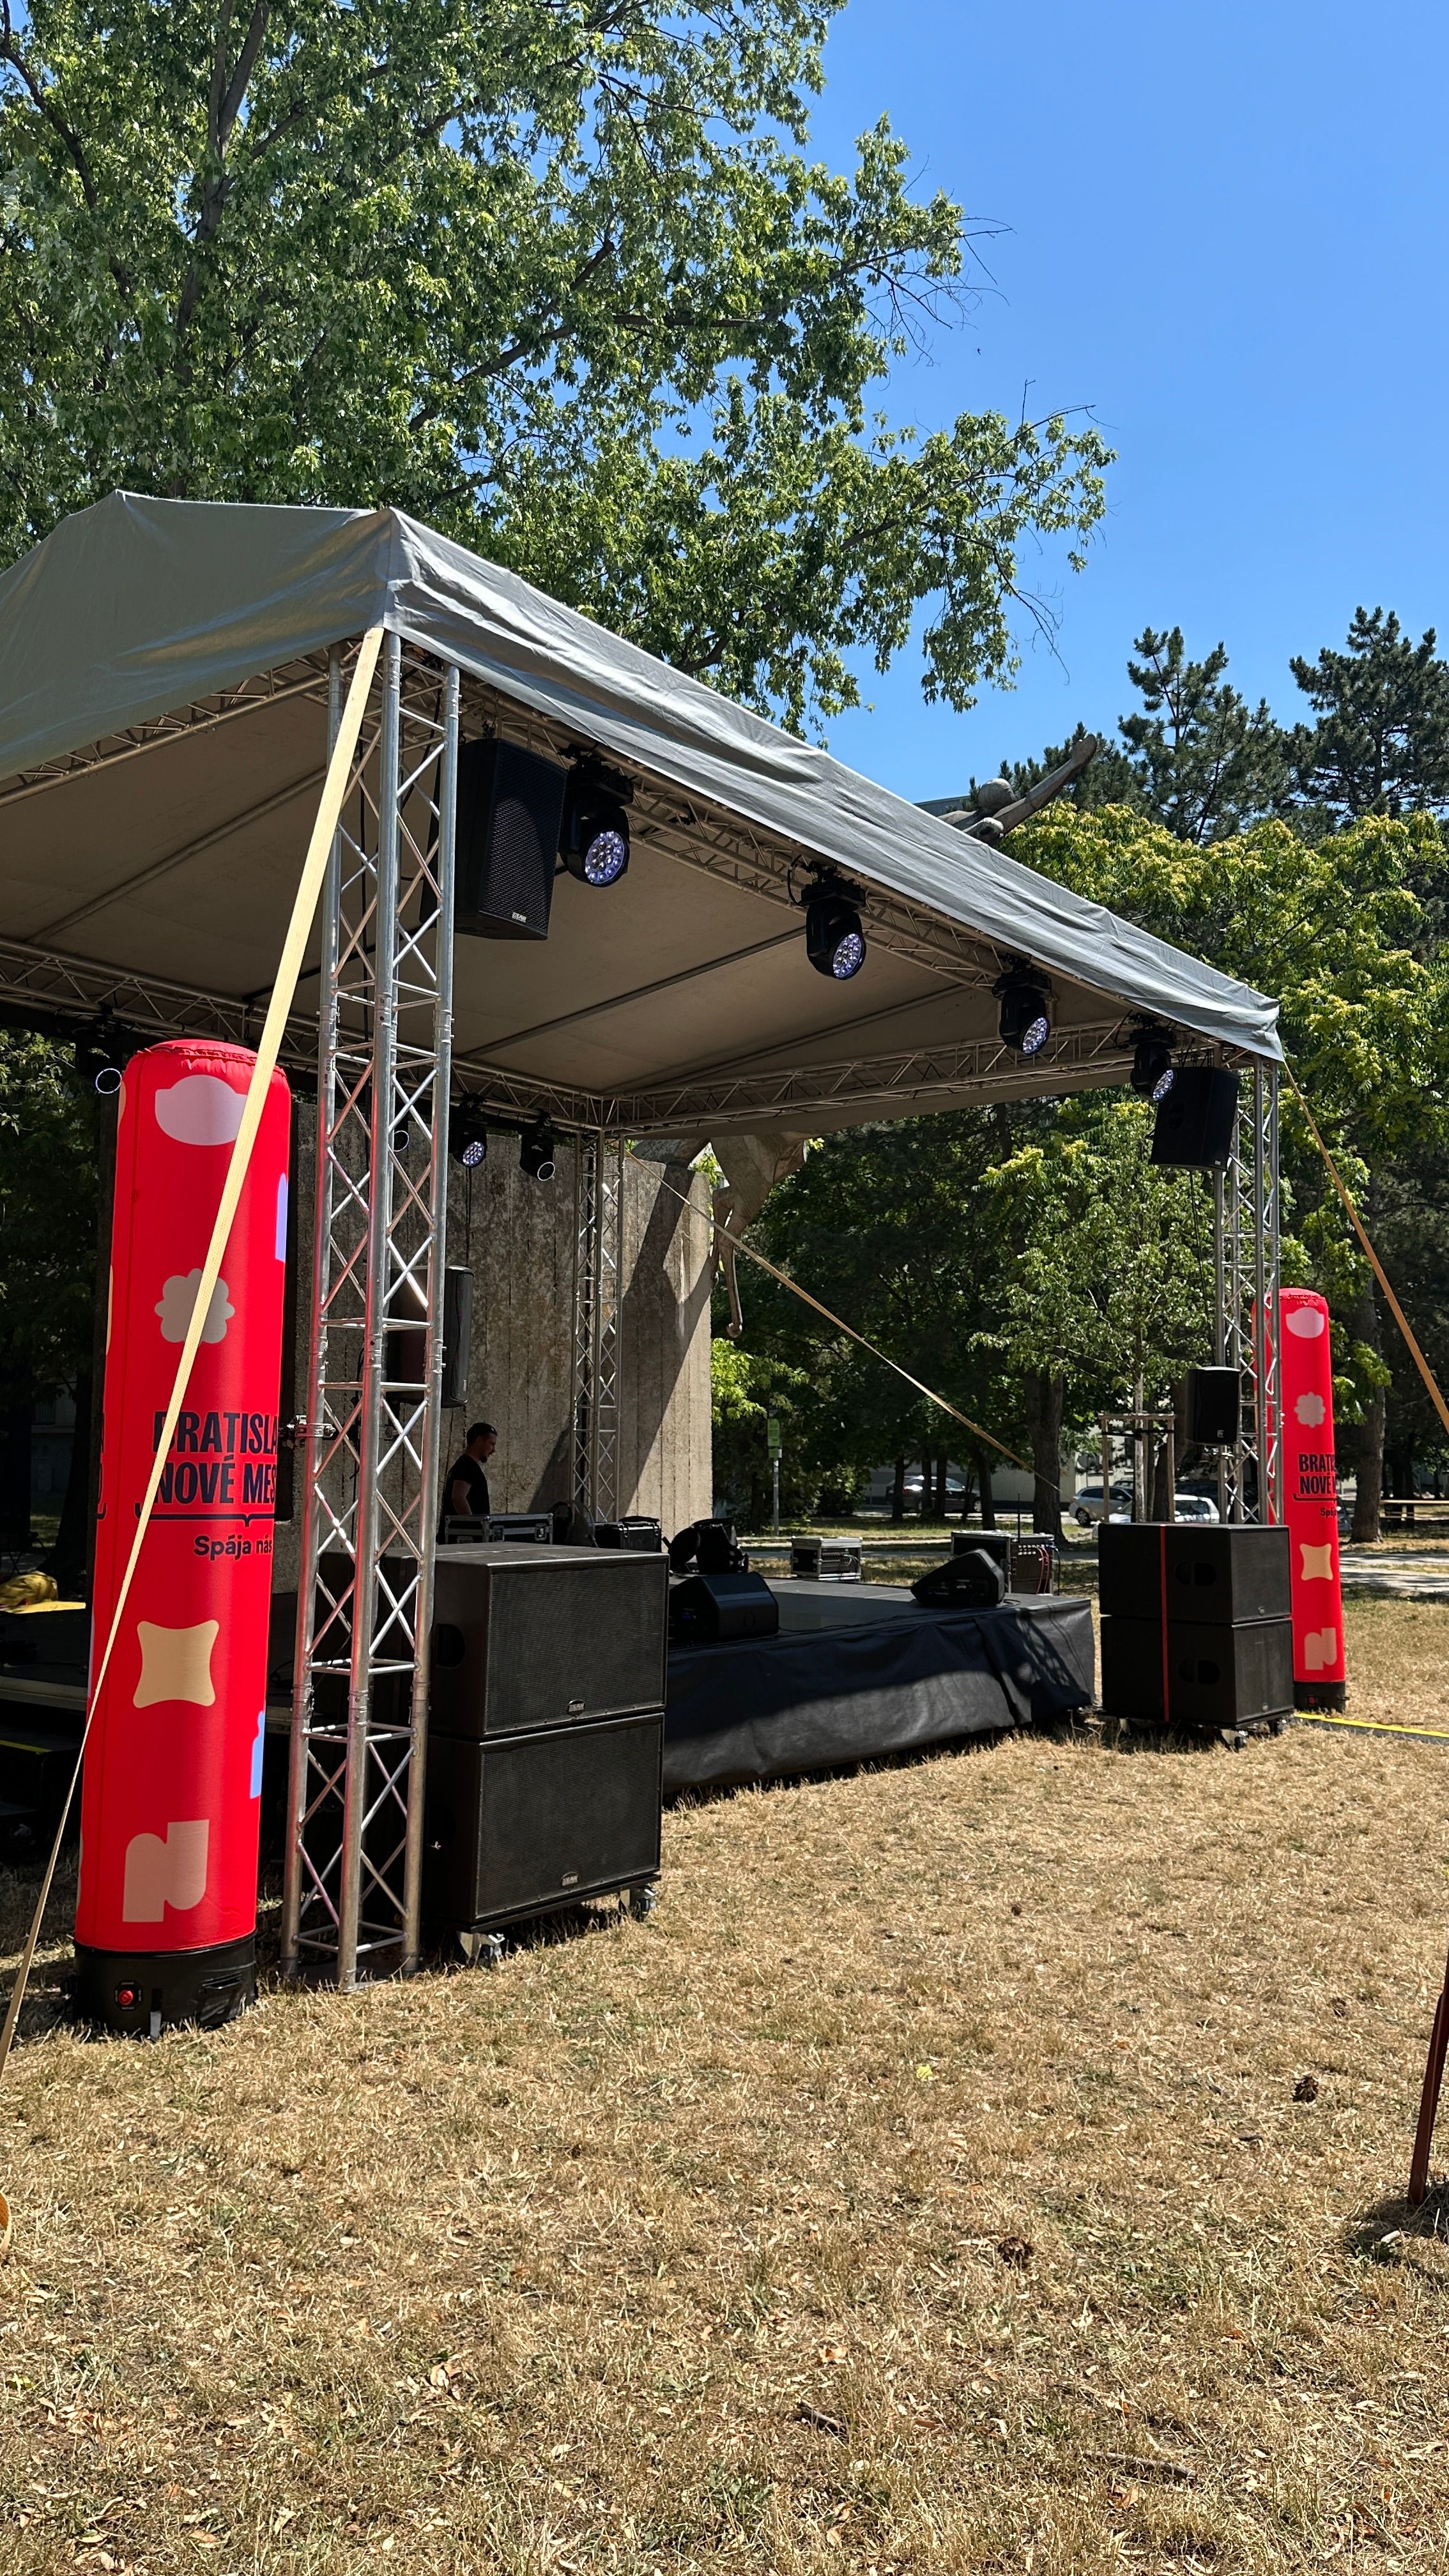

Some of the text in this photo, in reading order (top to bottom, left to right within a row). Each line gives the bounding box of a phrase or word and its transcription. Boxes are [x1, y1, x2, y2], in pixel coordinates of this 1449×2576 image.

[152, 1454, 236, 1505] NOVÉ
[194, 1533, 272, 1561] Spája nás
